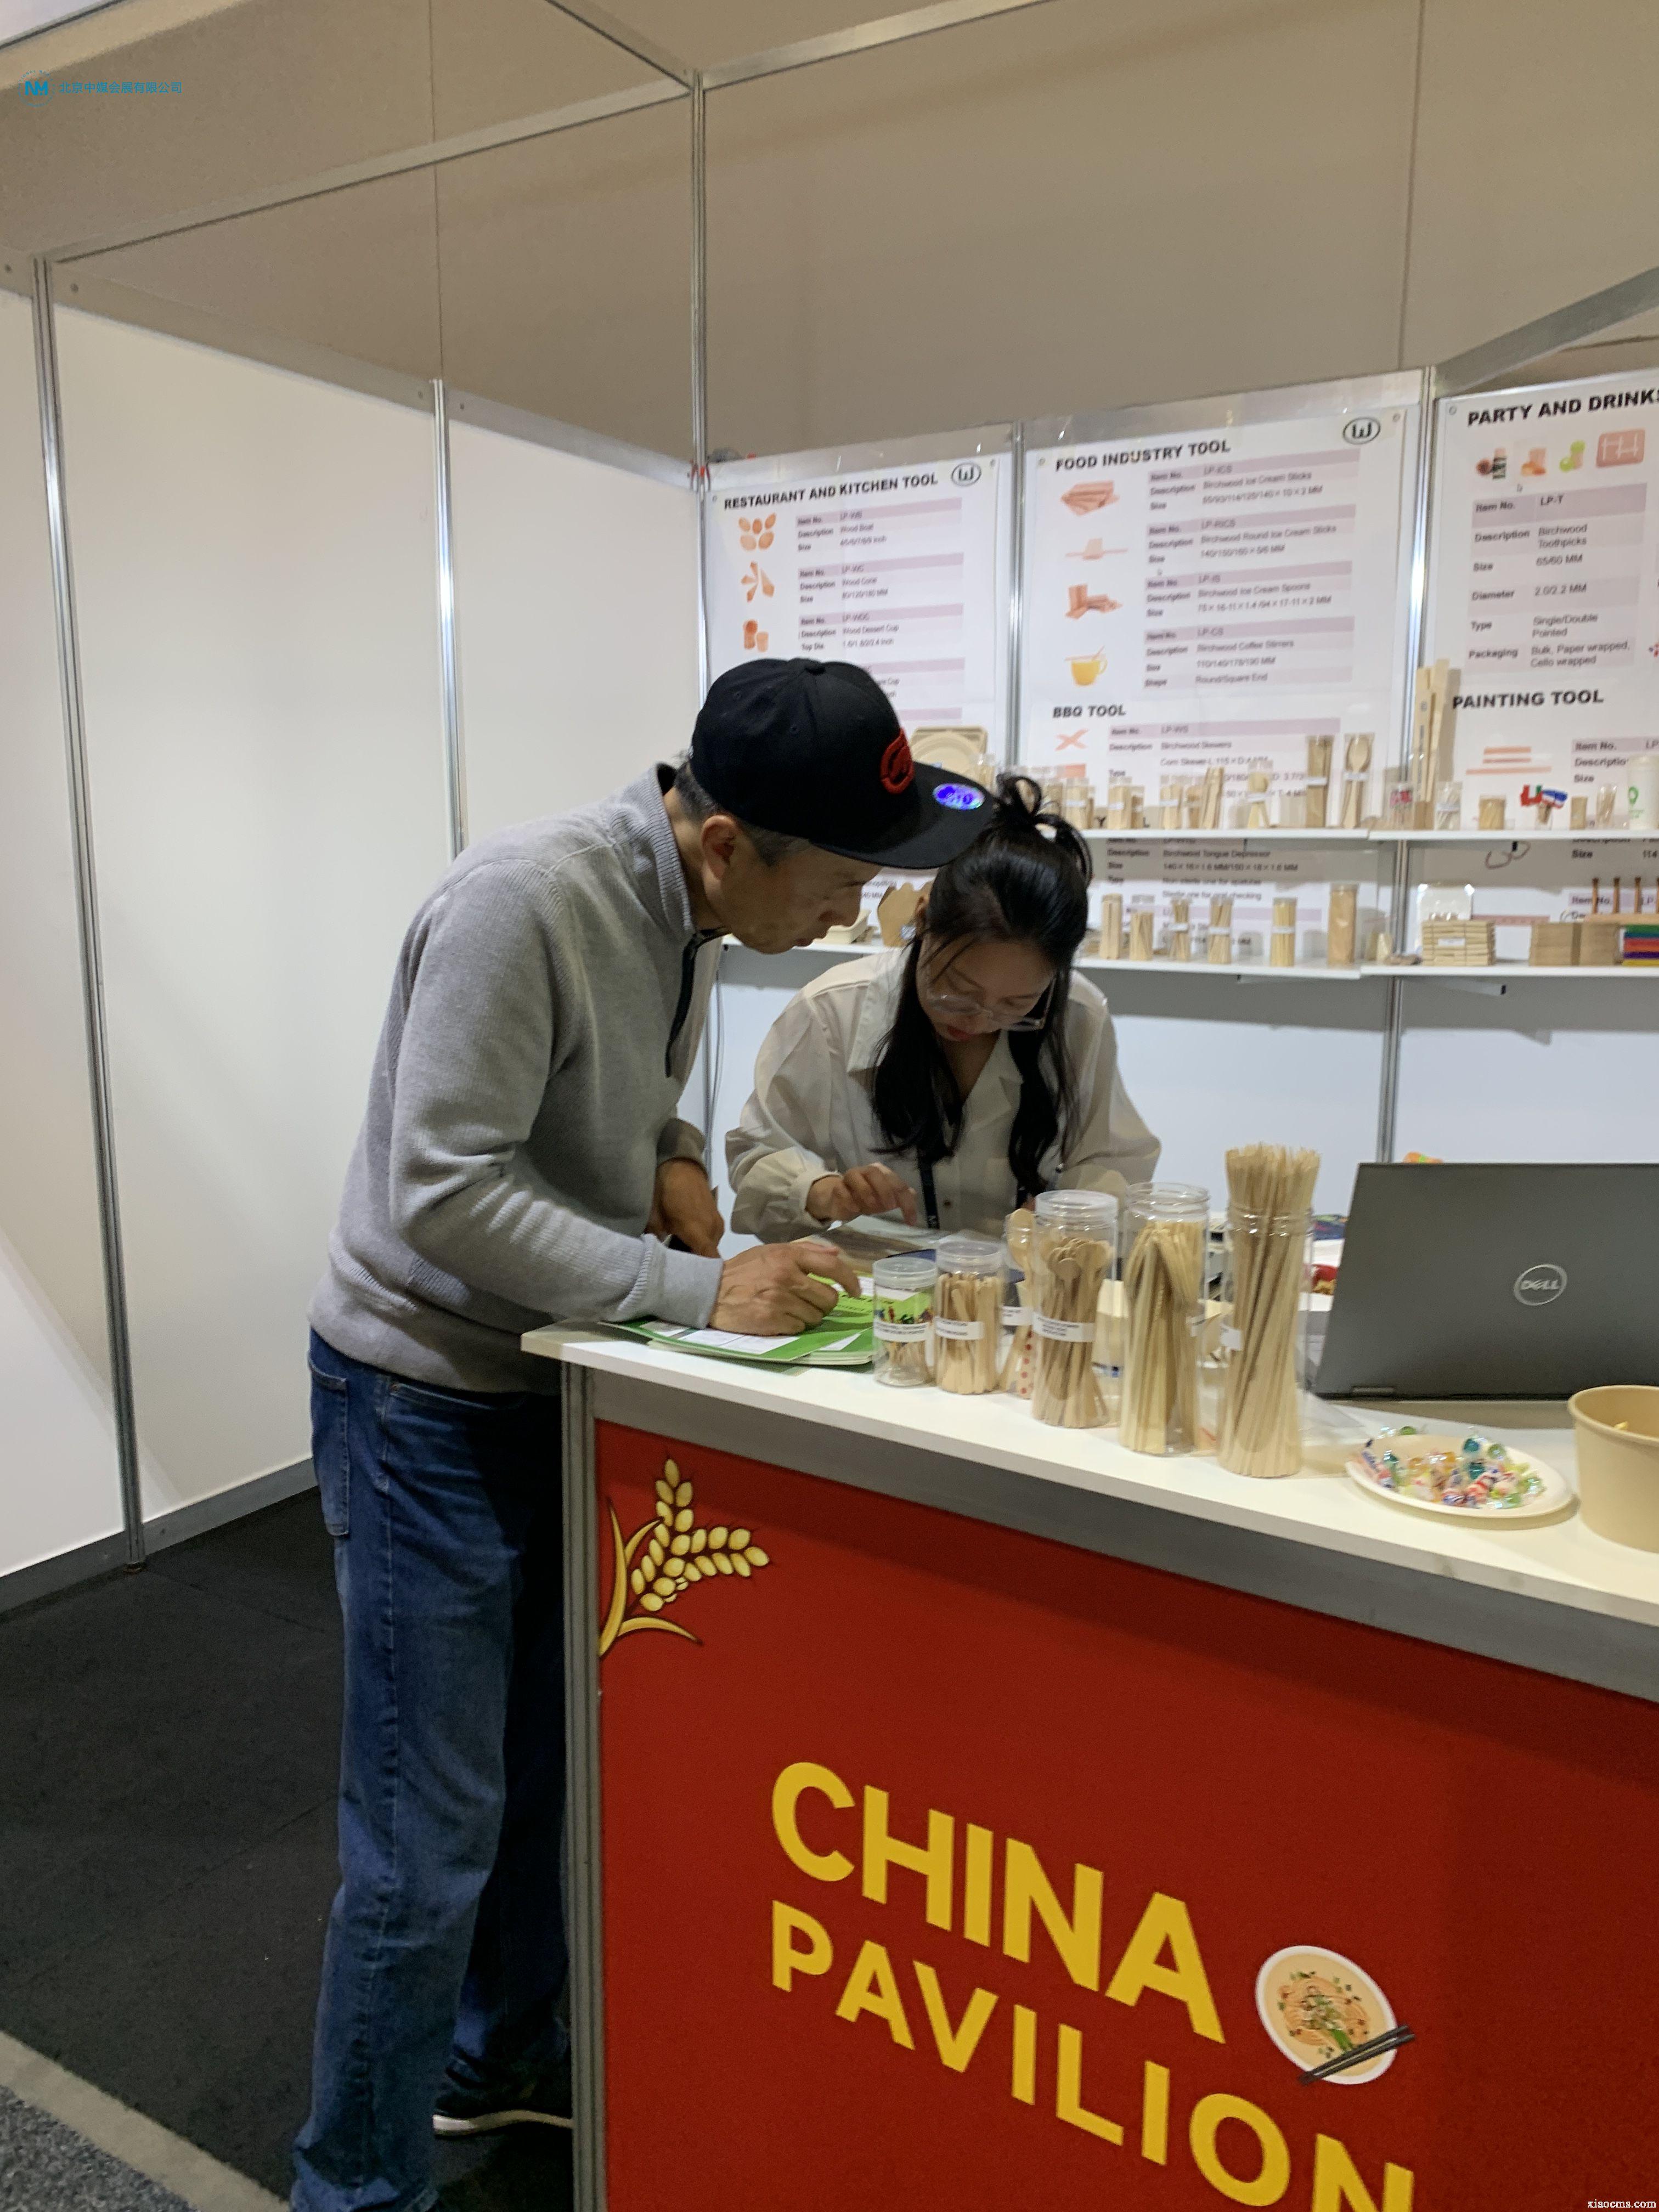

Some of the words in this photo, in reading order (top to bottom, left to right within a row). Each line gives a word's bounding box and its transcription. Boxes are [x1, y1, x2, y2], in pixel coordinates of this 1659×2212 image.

[1468, 404, 1532, 426] PARTY
[1538, 396, 1582, 418] AND
[1056, 455, 1098, 472] FOOD
[1102, 444, 1182, 467] INDUSTRY
[1189, 438, 1232, 458] TOOL
[724, 488, 804, 510] RESTAURANT
[809, 486, 836, 500] AND
[840, 478, 898, 496] KITCHEN
[903, 473, 938, 488] TOOL
[1474, 529, 1530, 543] Description
[1538, 523, 1588, 537] Birchwood
[1538, 537, 1587, 549] Toothpicks
[1473, 562, 1493, 572] Size
[1472, 589, 1515, 601] Diameter
[1570, 583, 1587, 593] MM
[1471, 620, 1492, 631] Type
[1533, 613, 1598, 627] Single/Double
[1469, 647, 1519, 661] Packaging
[1556, 644, 1585, 657] Paper
[1556, 656, 1596, 668] wrapped
[1452, 692, 1544, 709] PAINTING
[1550, 689, 1604, 705] TOOL
[1053, 705, 1082, 718] BBQ
[1088, 704, 1126, 717] TOOL
[1520, 1279, 1560, 1291] DELL
[772, 1762, 1226, 2044] CHINA
[772, 1899, 1414, 2212] PAVILION
